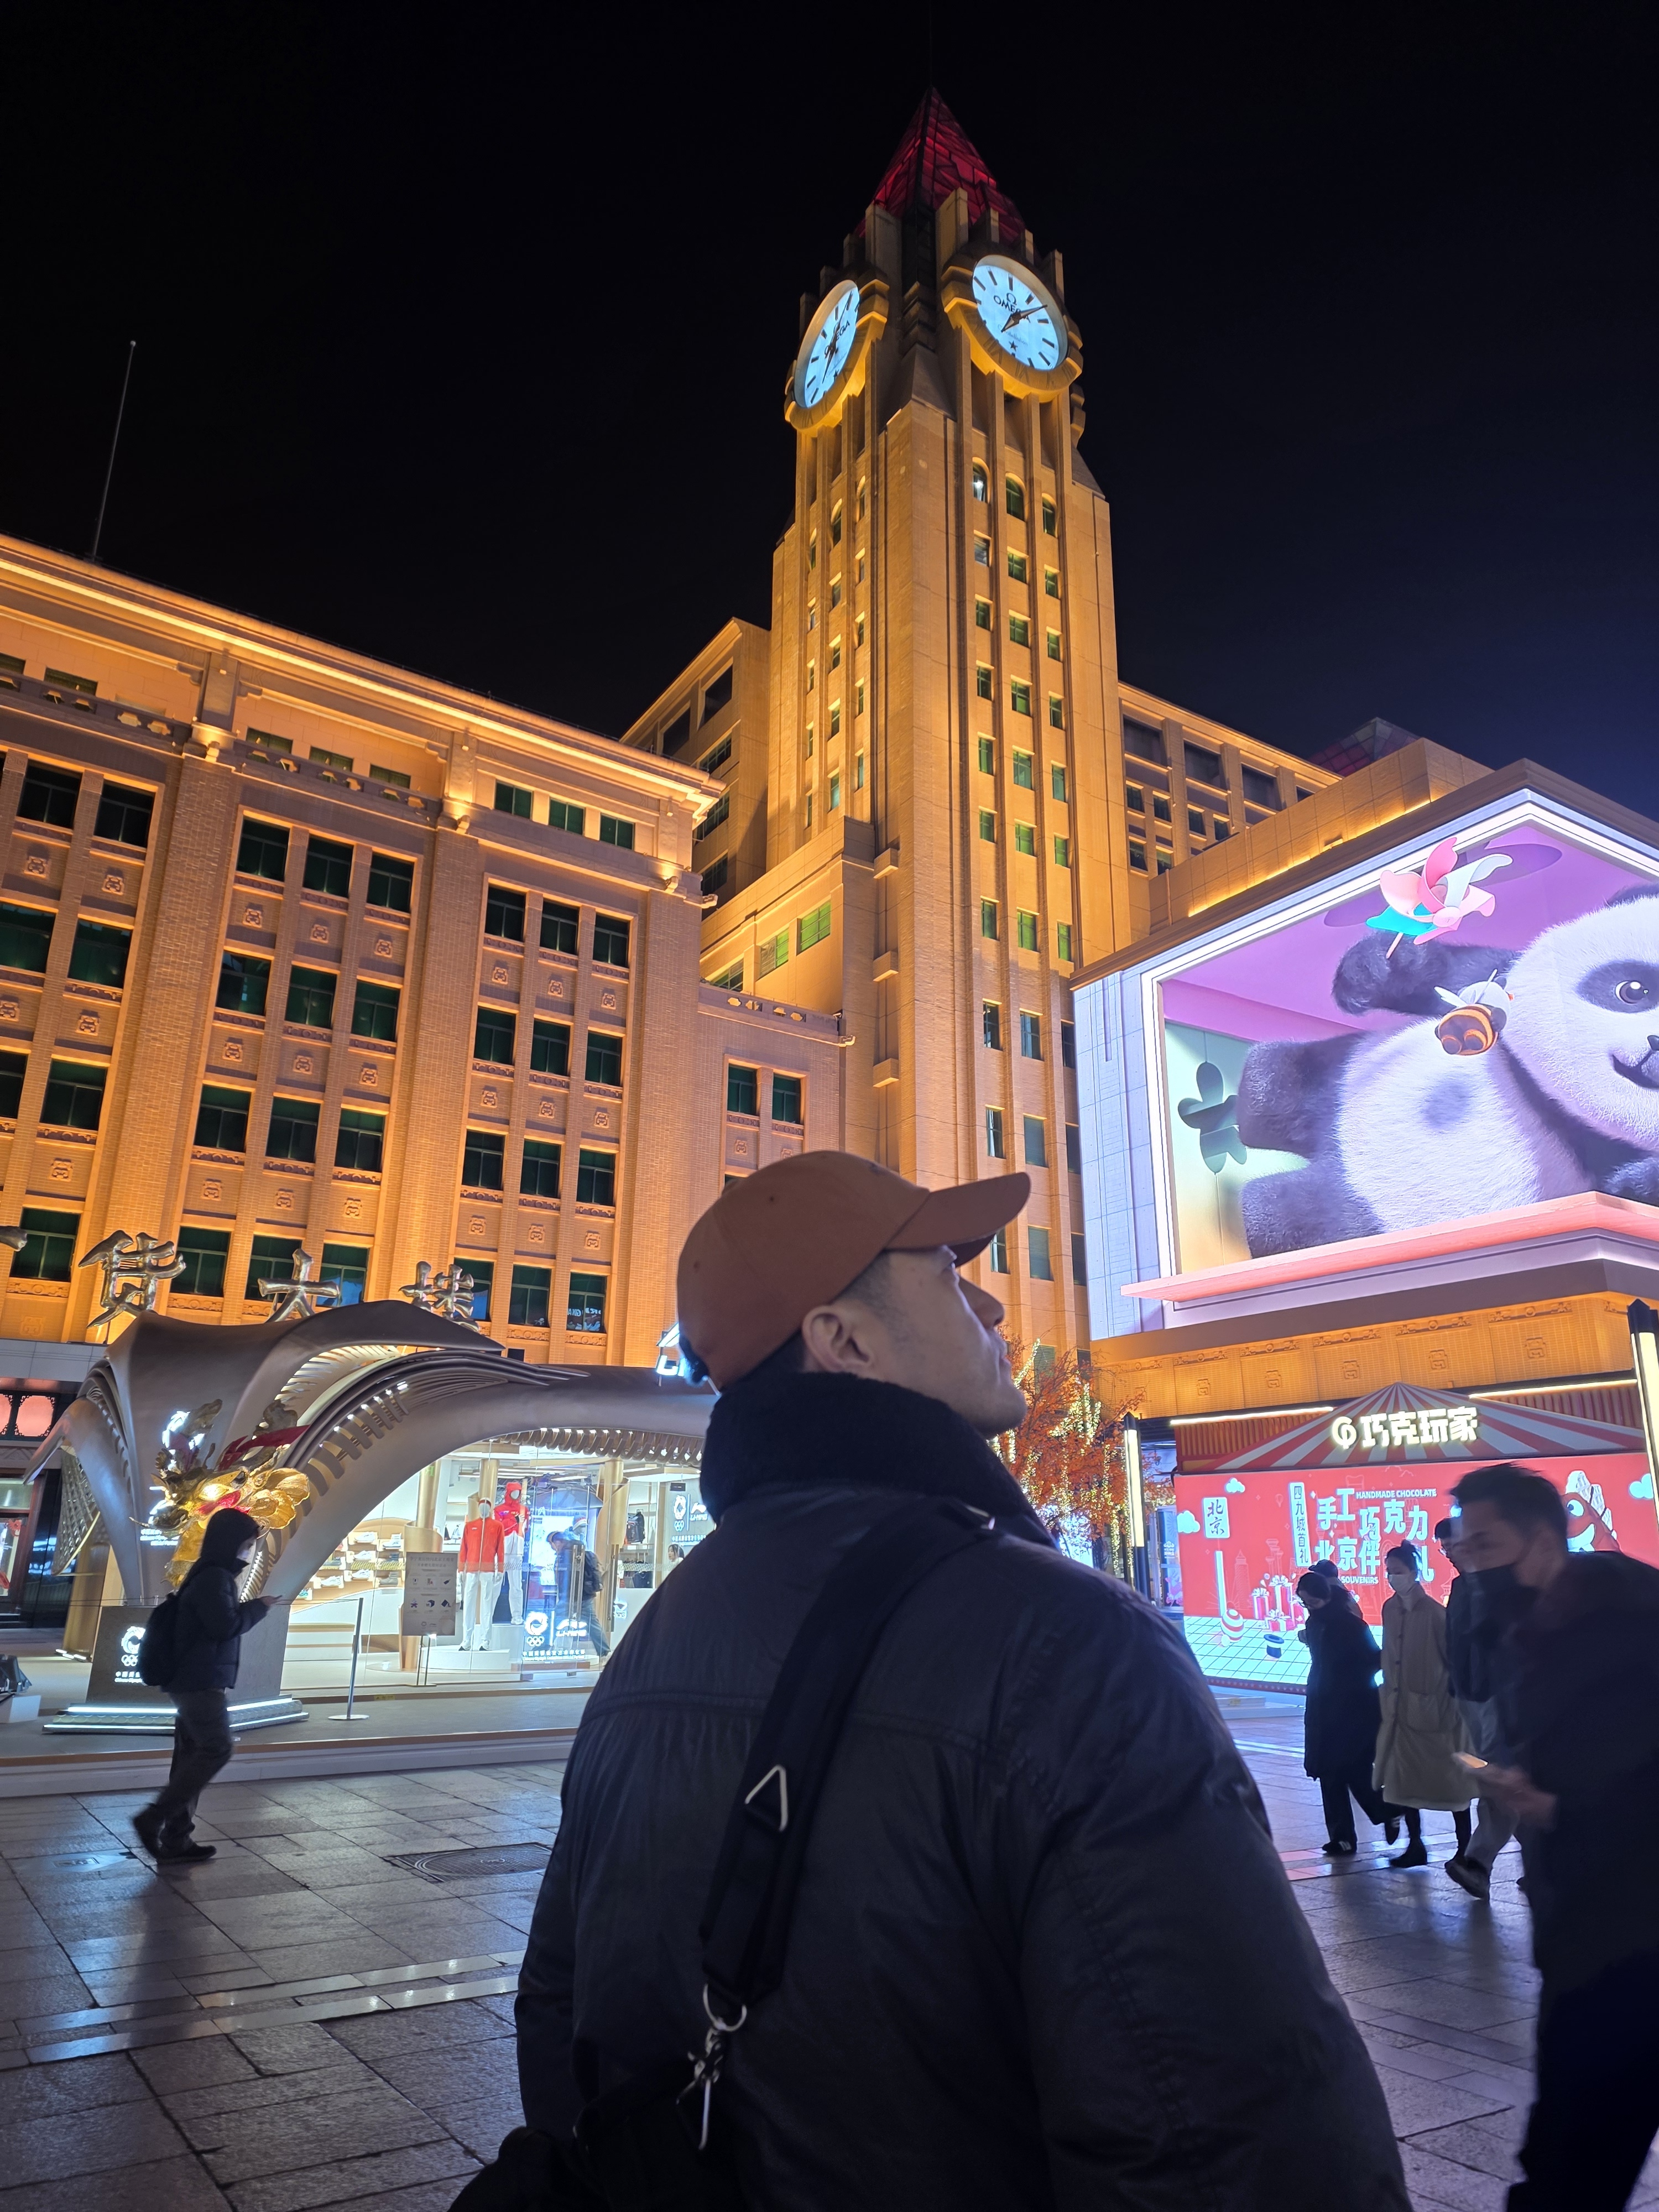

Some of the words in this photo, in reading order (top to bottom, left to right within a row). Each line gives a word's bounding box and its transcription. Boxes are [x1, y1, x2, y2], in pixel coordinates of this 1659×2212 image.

[825, 320, 850, 359] OEGA
[1360, 1406, 1478, 1447] 巧克玩家
[1356, 1490, 1395, 1499] HANDMADE
[1396, 1488, 1437, 1498] CHOCOLATE
[1207, 1499, 1225, 1536] 北京
[1294, 1485, 1309, 1564] 四九城首礼
[1317, 1488, 1428, 1542] 手工巧克力
[1315, 1536, 1434, 1583] 北京伴礼
[1341, 1575, 1379, 1585] SOUVENIRS
